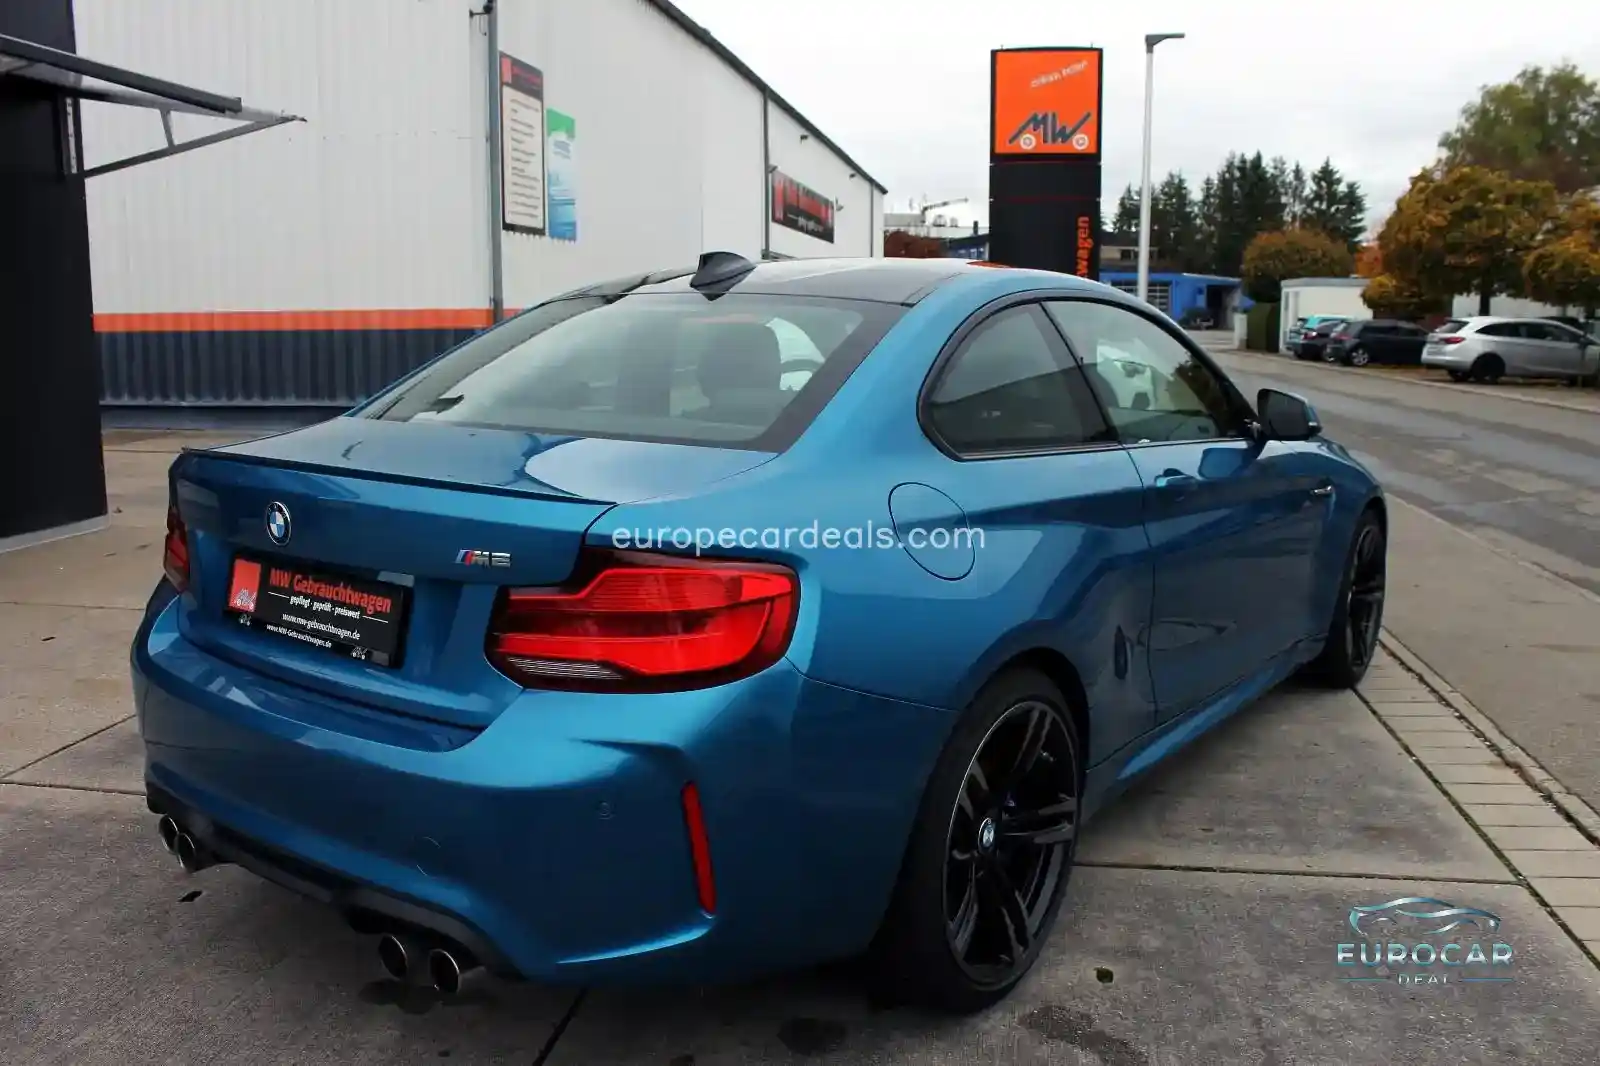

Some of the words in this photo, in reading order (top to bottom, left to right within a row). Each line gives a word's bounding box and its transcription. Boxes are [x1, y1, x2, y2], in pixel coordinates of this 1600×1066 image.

[269, 567, 292, 589] MW
[293, 574, 392, 615] Gebrauchtwagen
[282, 613, 361, 640] www.mw-gebrauchtwagen.de
[334, 607, 361, 619] preiswert
